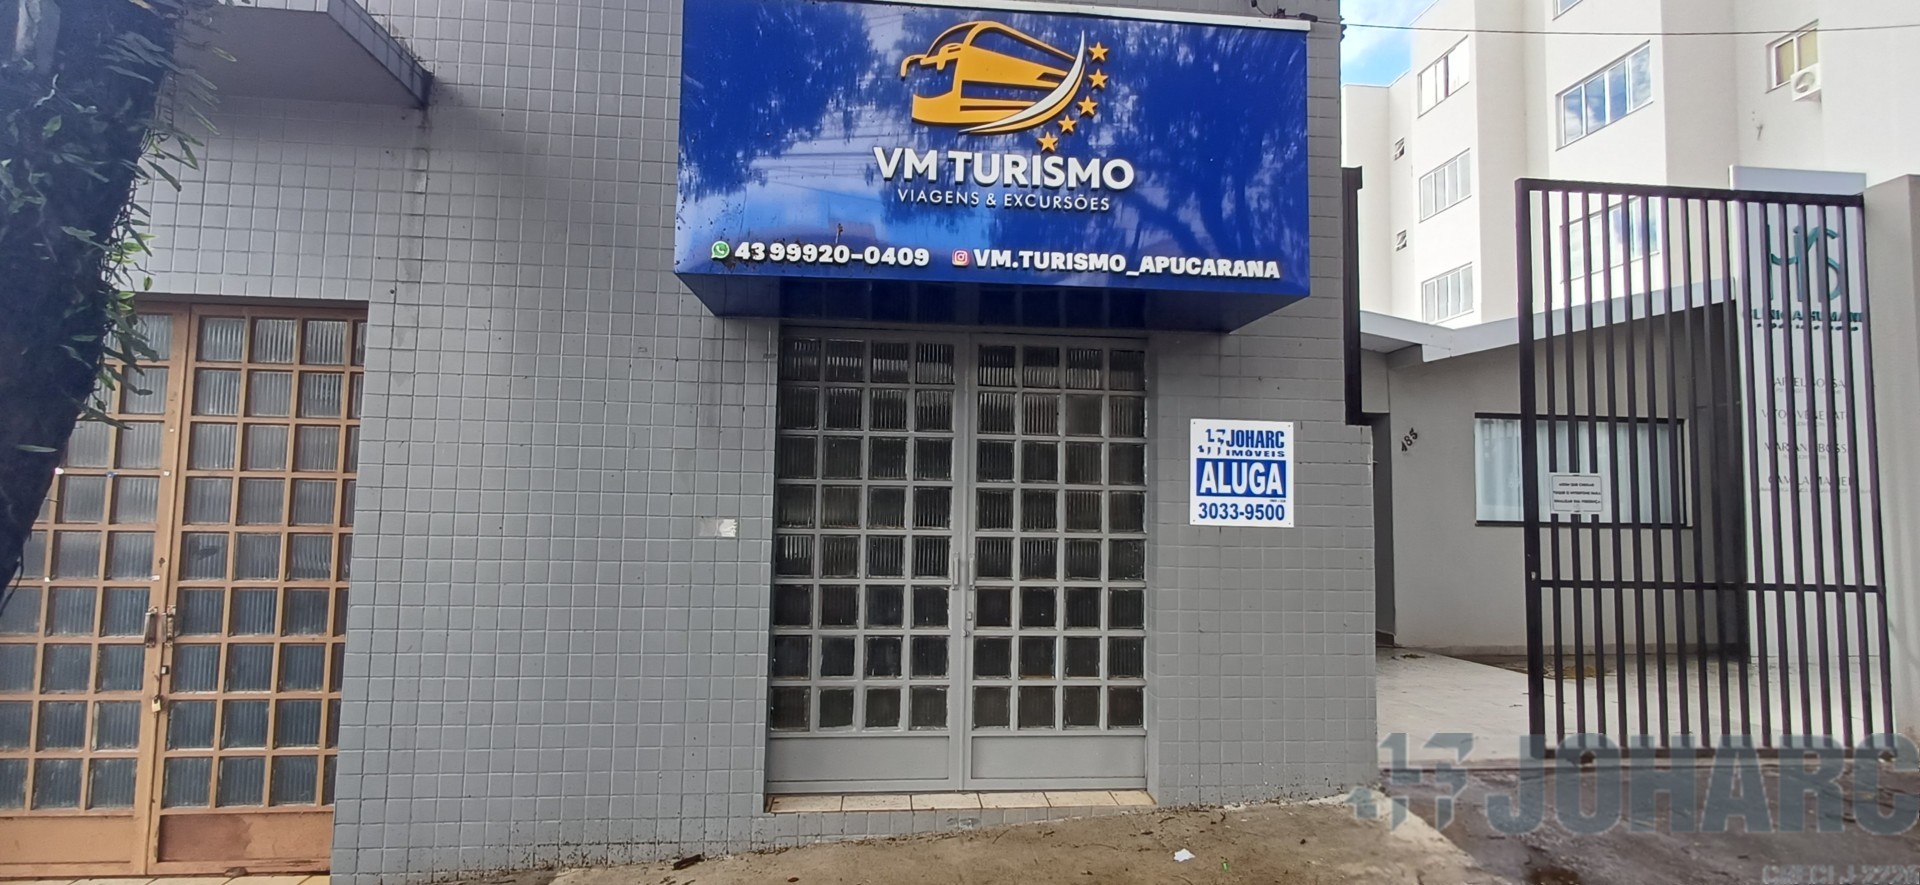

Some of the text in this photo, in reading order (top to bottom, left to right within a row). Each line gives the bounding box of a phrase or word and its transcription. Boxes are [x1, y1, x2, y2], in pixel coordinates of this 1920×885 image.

[873, 146, 1135, 191] VM TURISMO
[897, 188, 1110, 211] VIAGENS & EXCURSÕES
[734, 241, 930, 267] 43 99920-0409
[973, 249, 1281, 279] VM.TURISMO_APUCARANA
[1226, 429, 1285, 448] JOHARC
[1226, 449, 1285, 457] IMÓVEIS
[1199, 461, 1284, 495] ALUGA
[1198, 502, 1285, 521] 3033-9500
